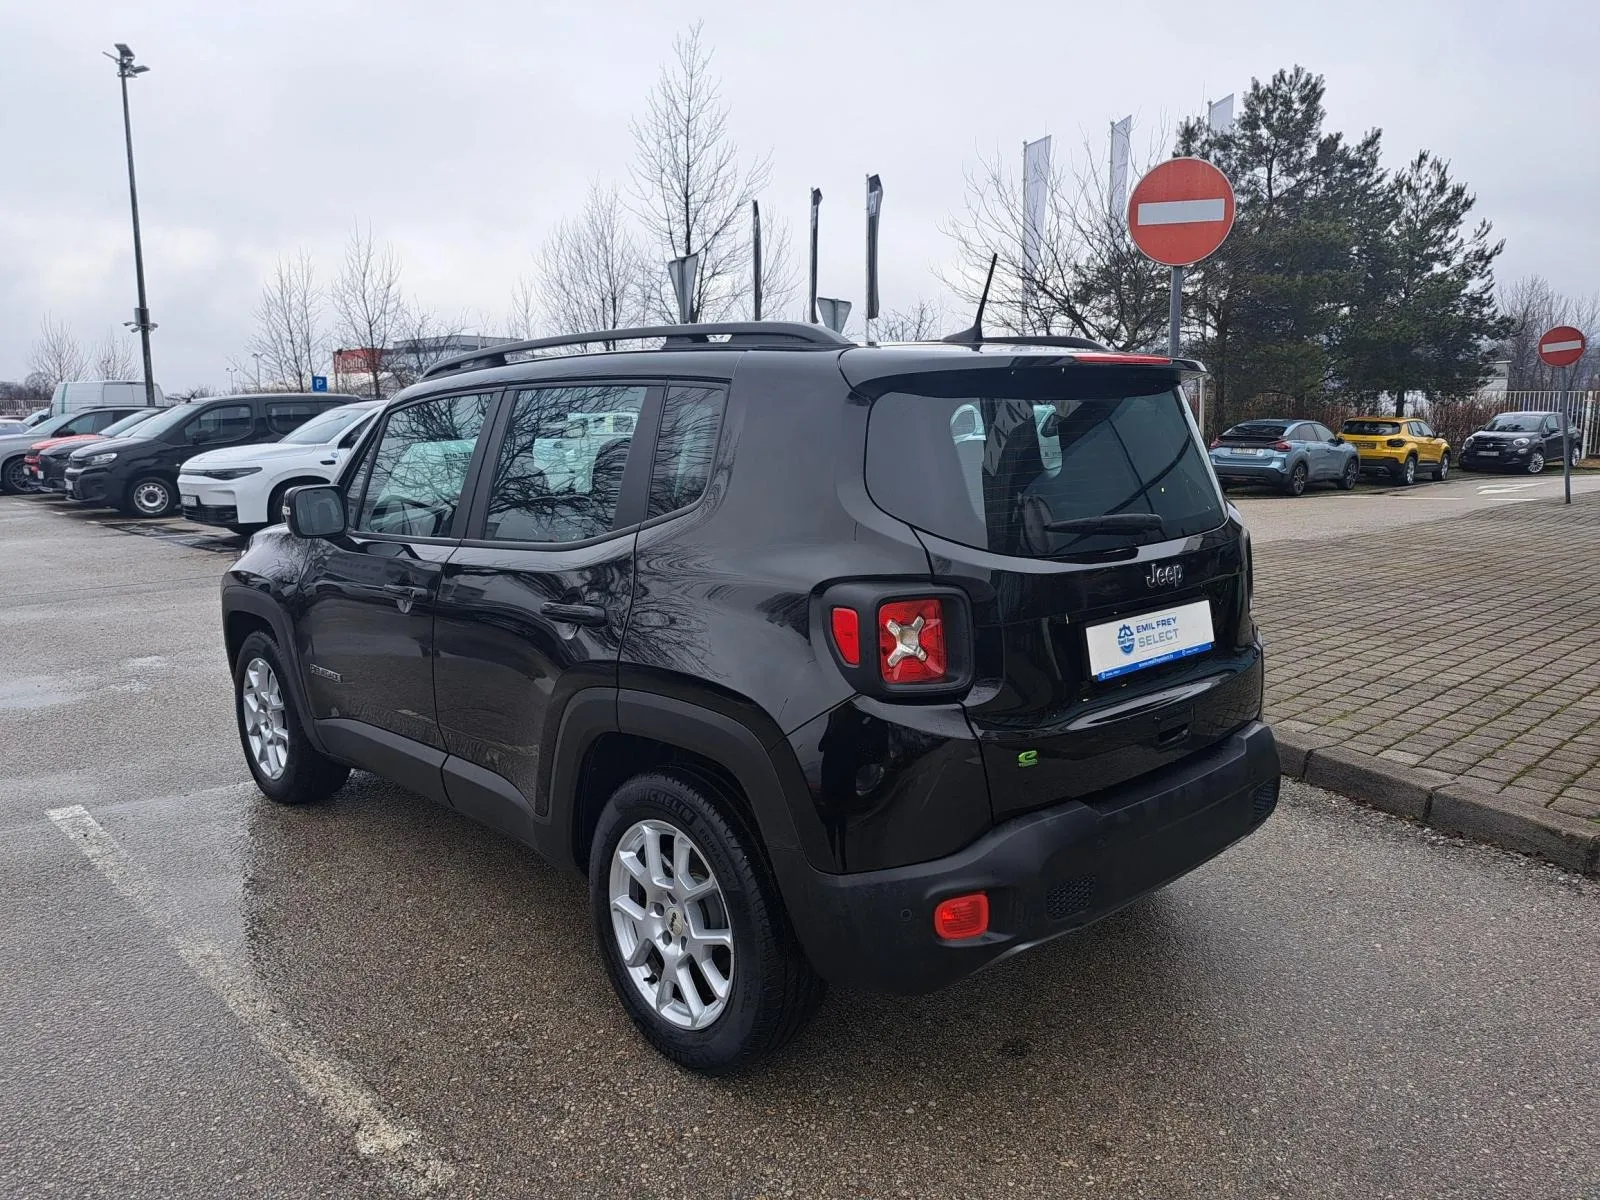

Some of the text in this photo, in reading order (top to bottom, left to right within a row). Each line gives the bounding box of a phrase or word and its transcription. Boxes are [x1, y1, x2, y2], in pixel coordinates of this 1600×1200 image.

[316, 379, 323, 389] P
[1146, 563, 1183, 588] Jeep
[1136, 616, 1177, 633] EMIL FREY
[1138, 628, 1179, 648] SELECT
